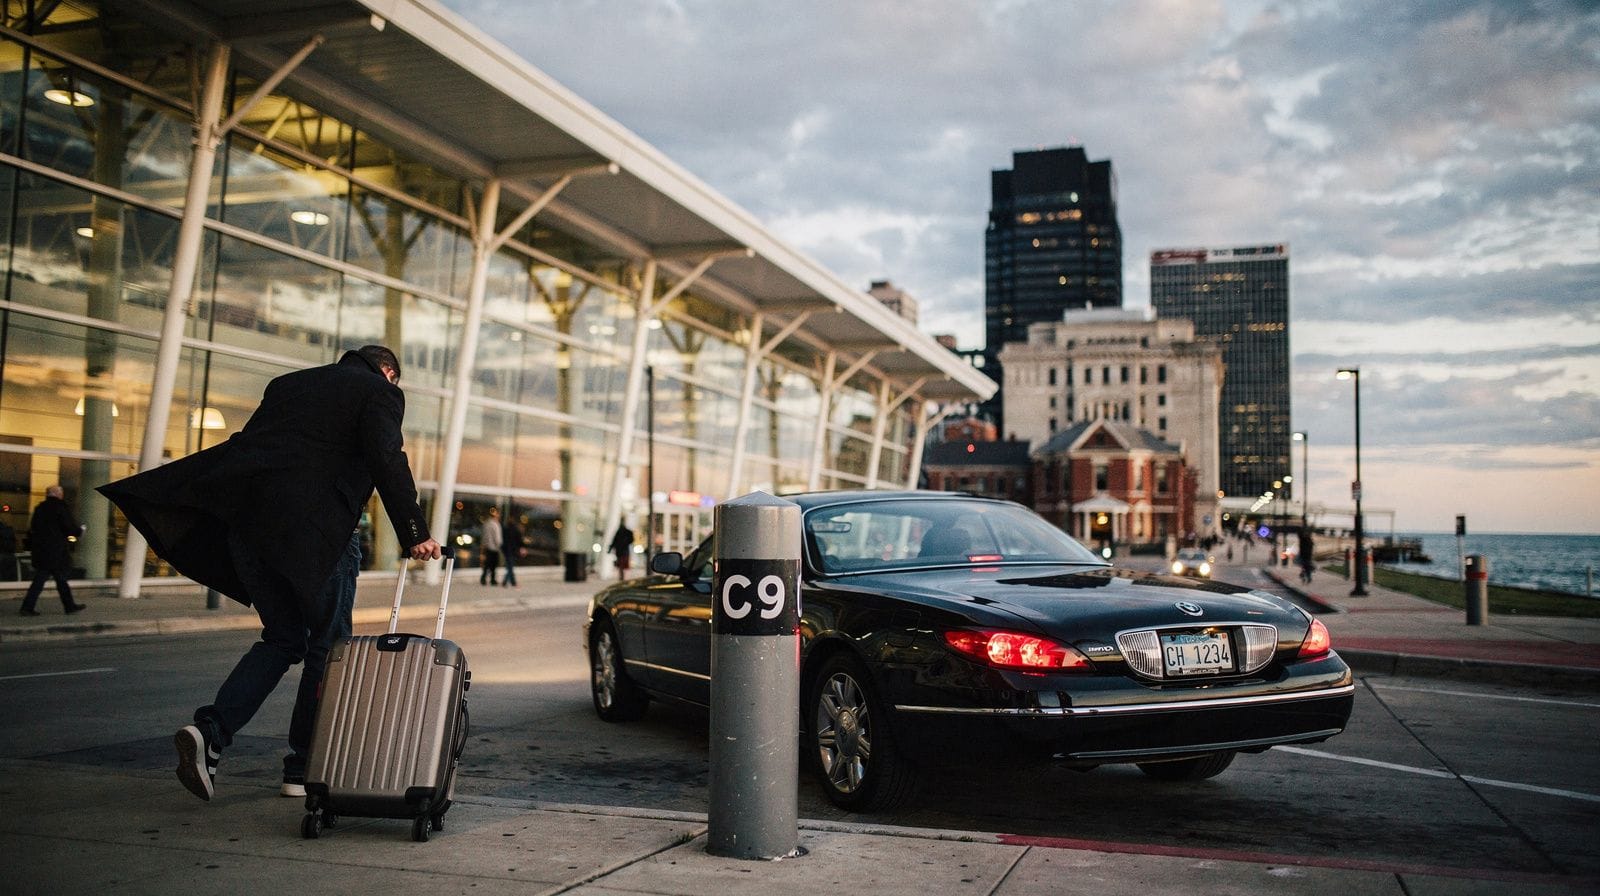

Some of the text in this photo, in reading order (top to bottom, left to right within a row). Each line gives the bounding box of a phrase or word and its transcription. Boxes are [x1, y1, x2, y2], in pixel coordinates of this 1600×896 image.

[722, 574, 786, 620] C9
[1166, 643, 1230, 667] CH 1234
